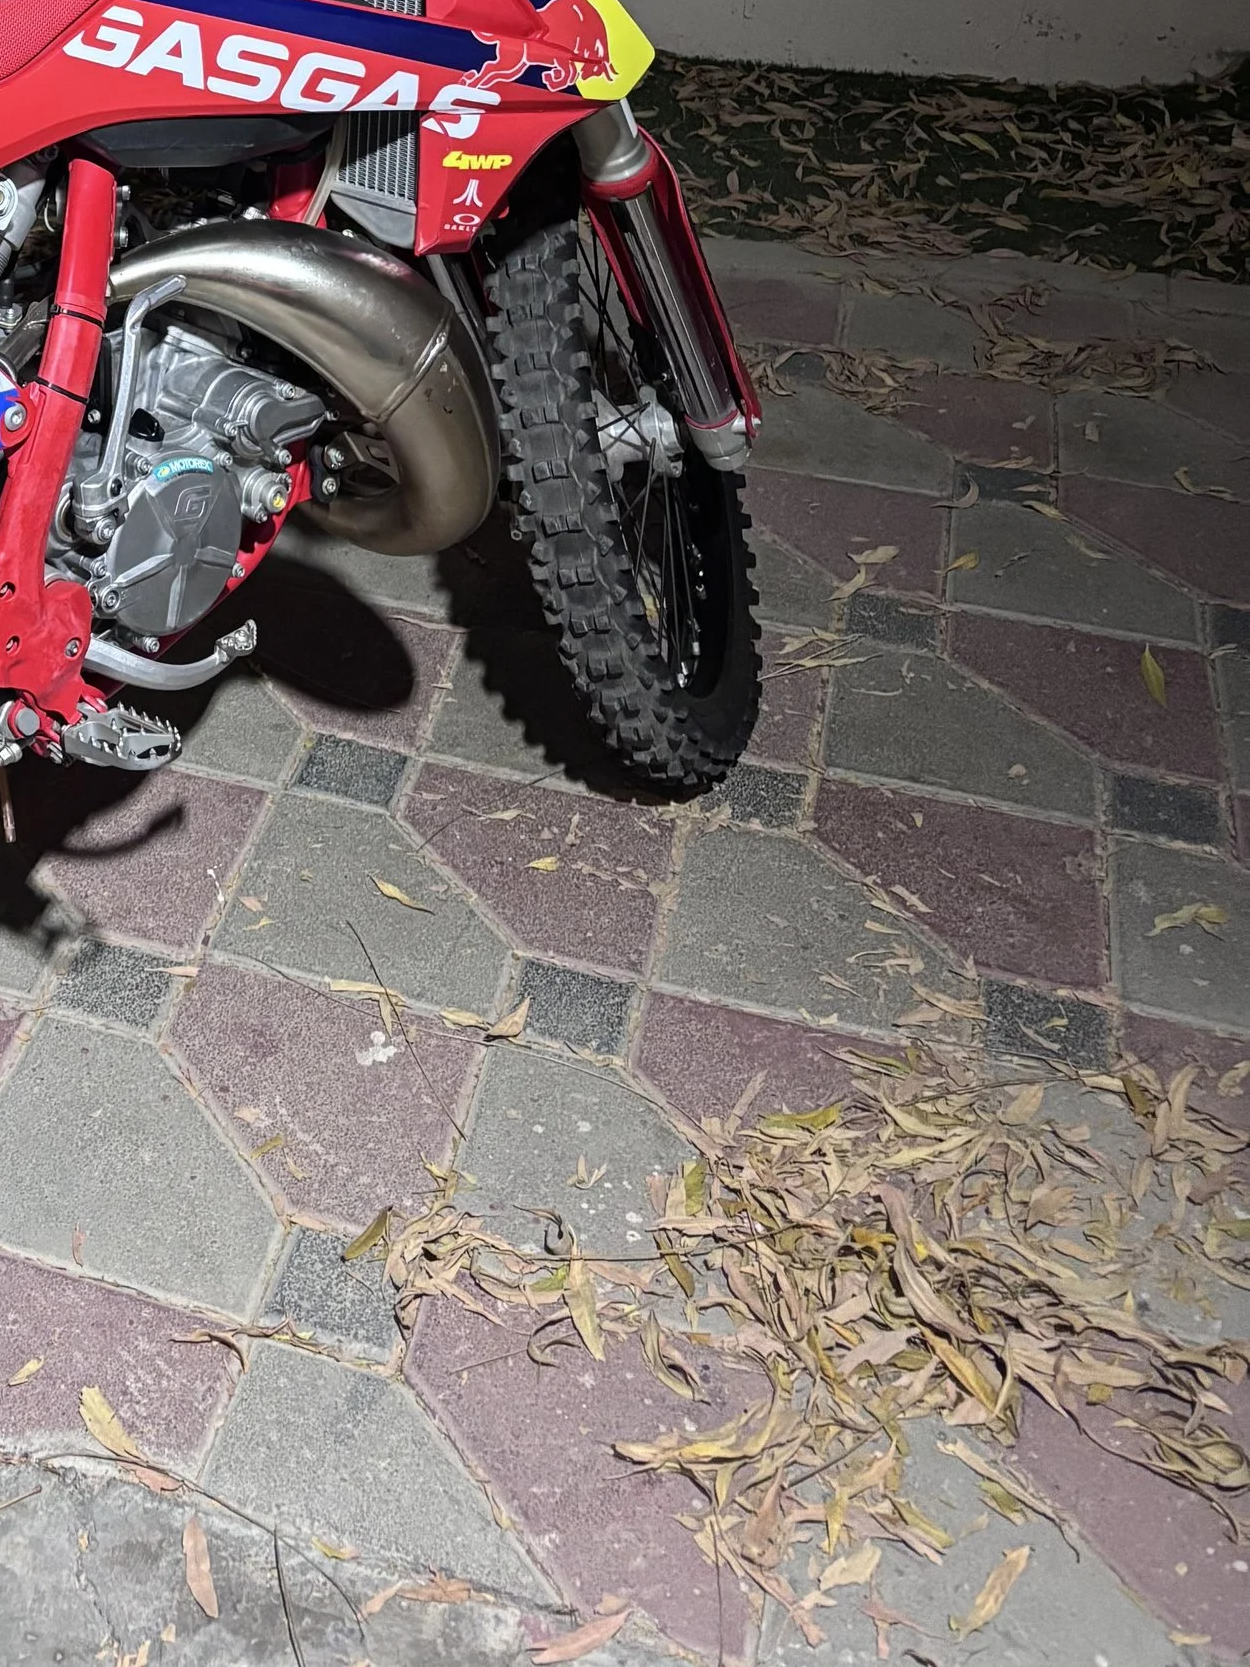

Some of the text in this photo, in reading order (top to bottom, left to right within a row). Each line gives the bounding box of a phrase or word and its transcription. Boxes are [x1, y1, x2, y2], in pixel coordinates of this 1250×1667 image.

[63, 5, 501, 139] GASGAS
[442, 150, 513, 170] 4WP
[168, 457, 213, 474] MOTOREX
